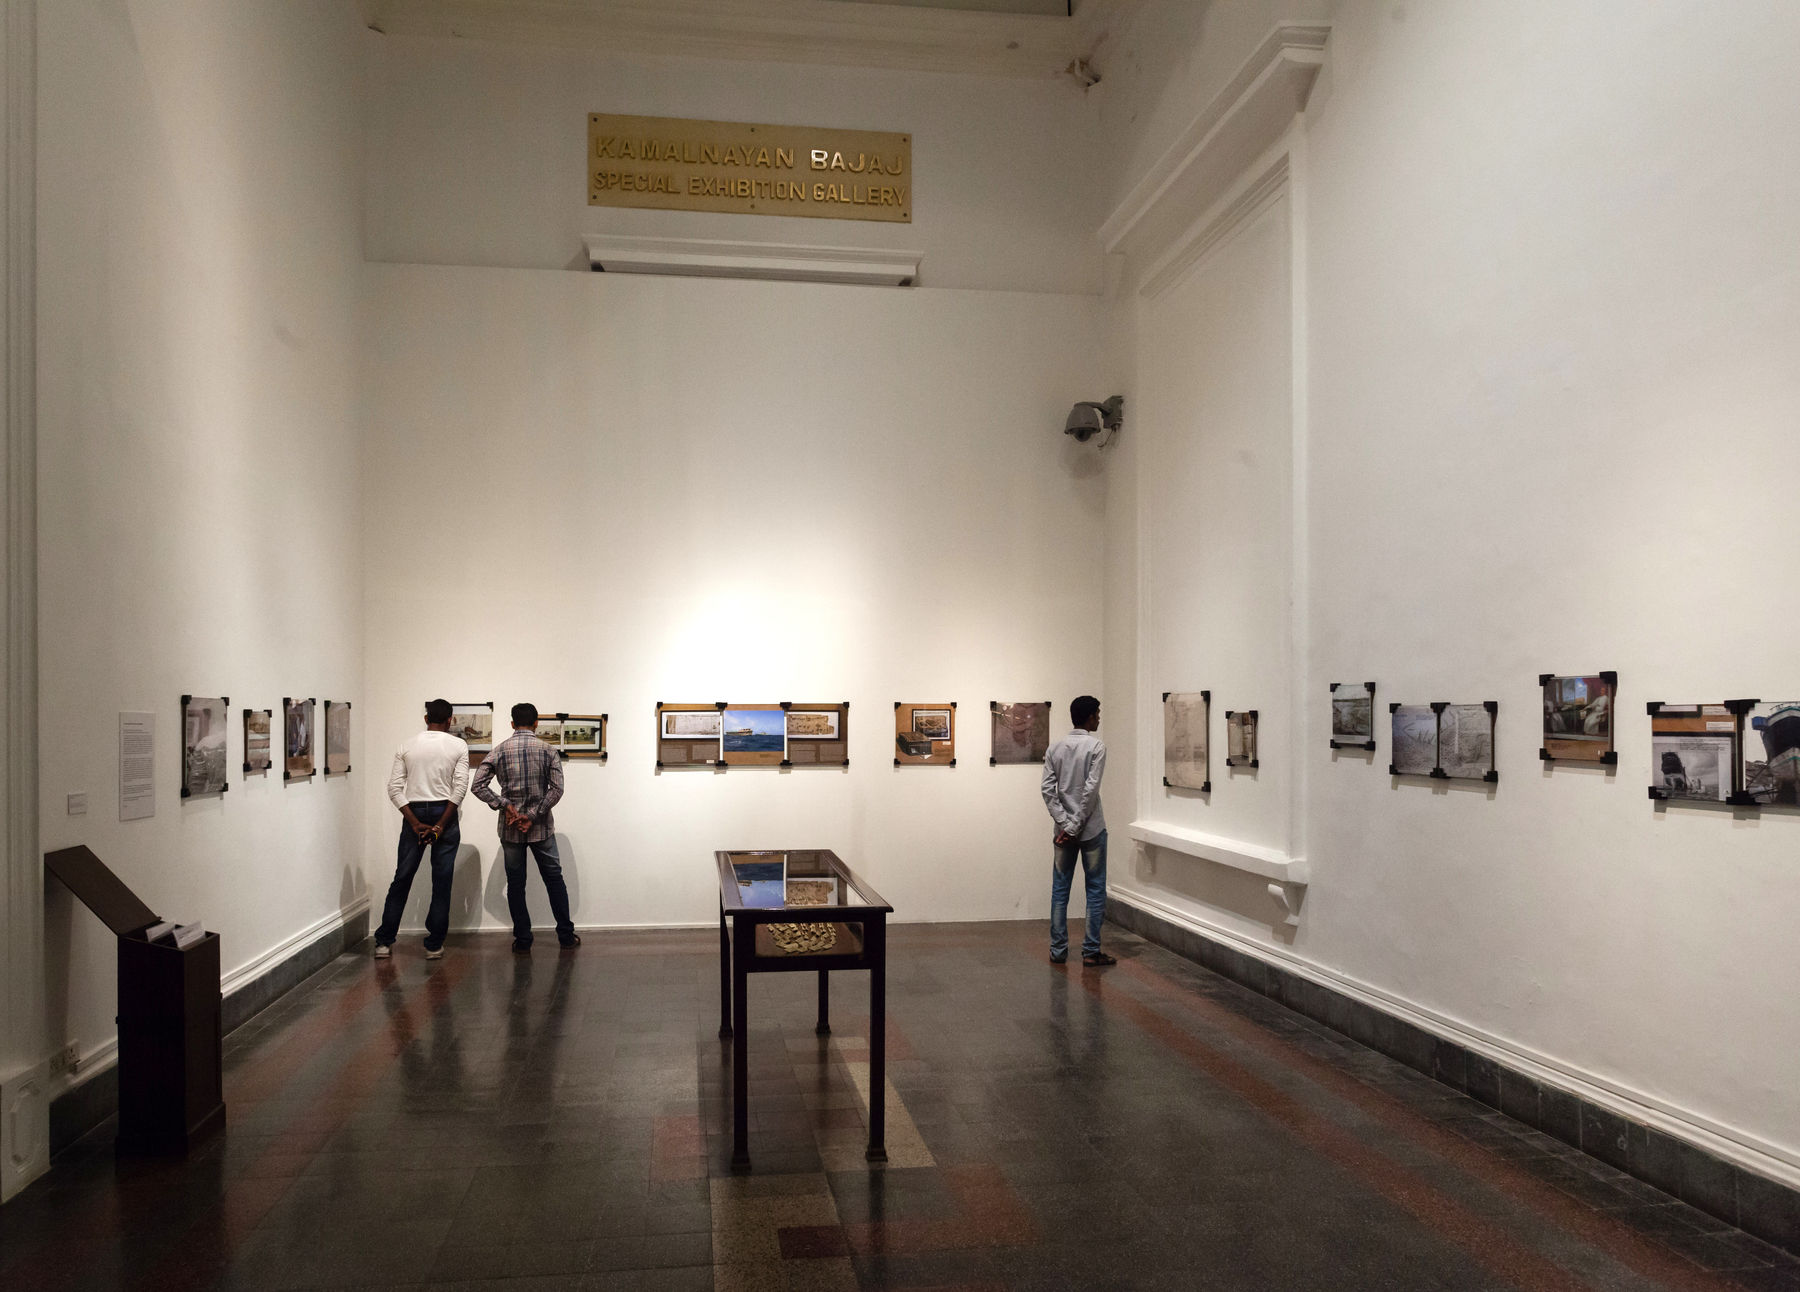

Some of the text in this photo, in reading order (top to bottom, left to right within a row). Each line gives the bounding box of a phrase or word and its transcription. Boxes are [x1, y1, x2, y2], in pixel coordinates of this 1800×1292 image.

[597, 137, 903, 176] KAMALNAYAN BAJAJ
[594, 170, 905, 206] SPECIAL EXHIBITION GALLERY
